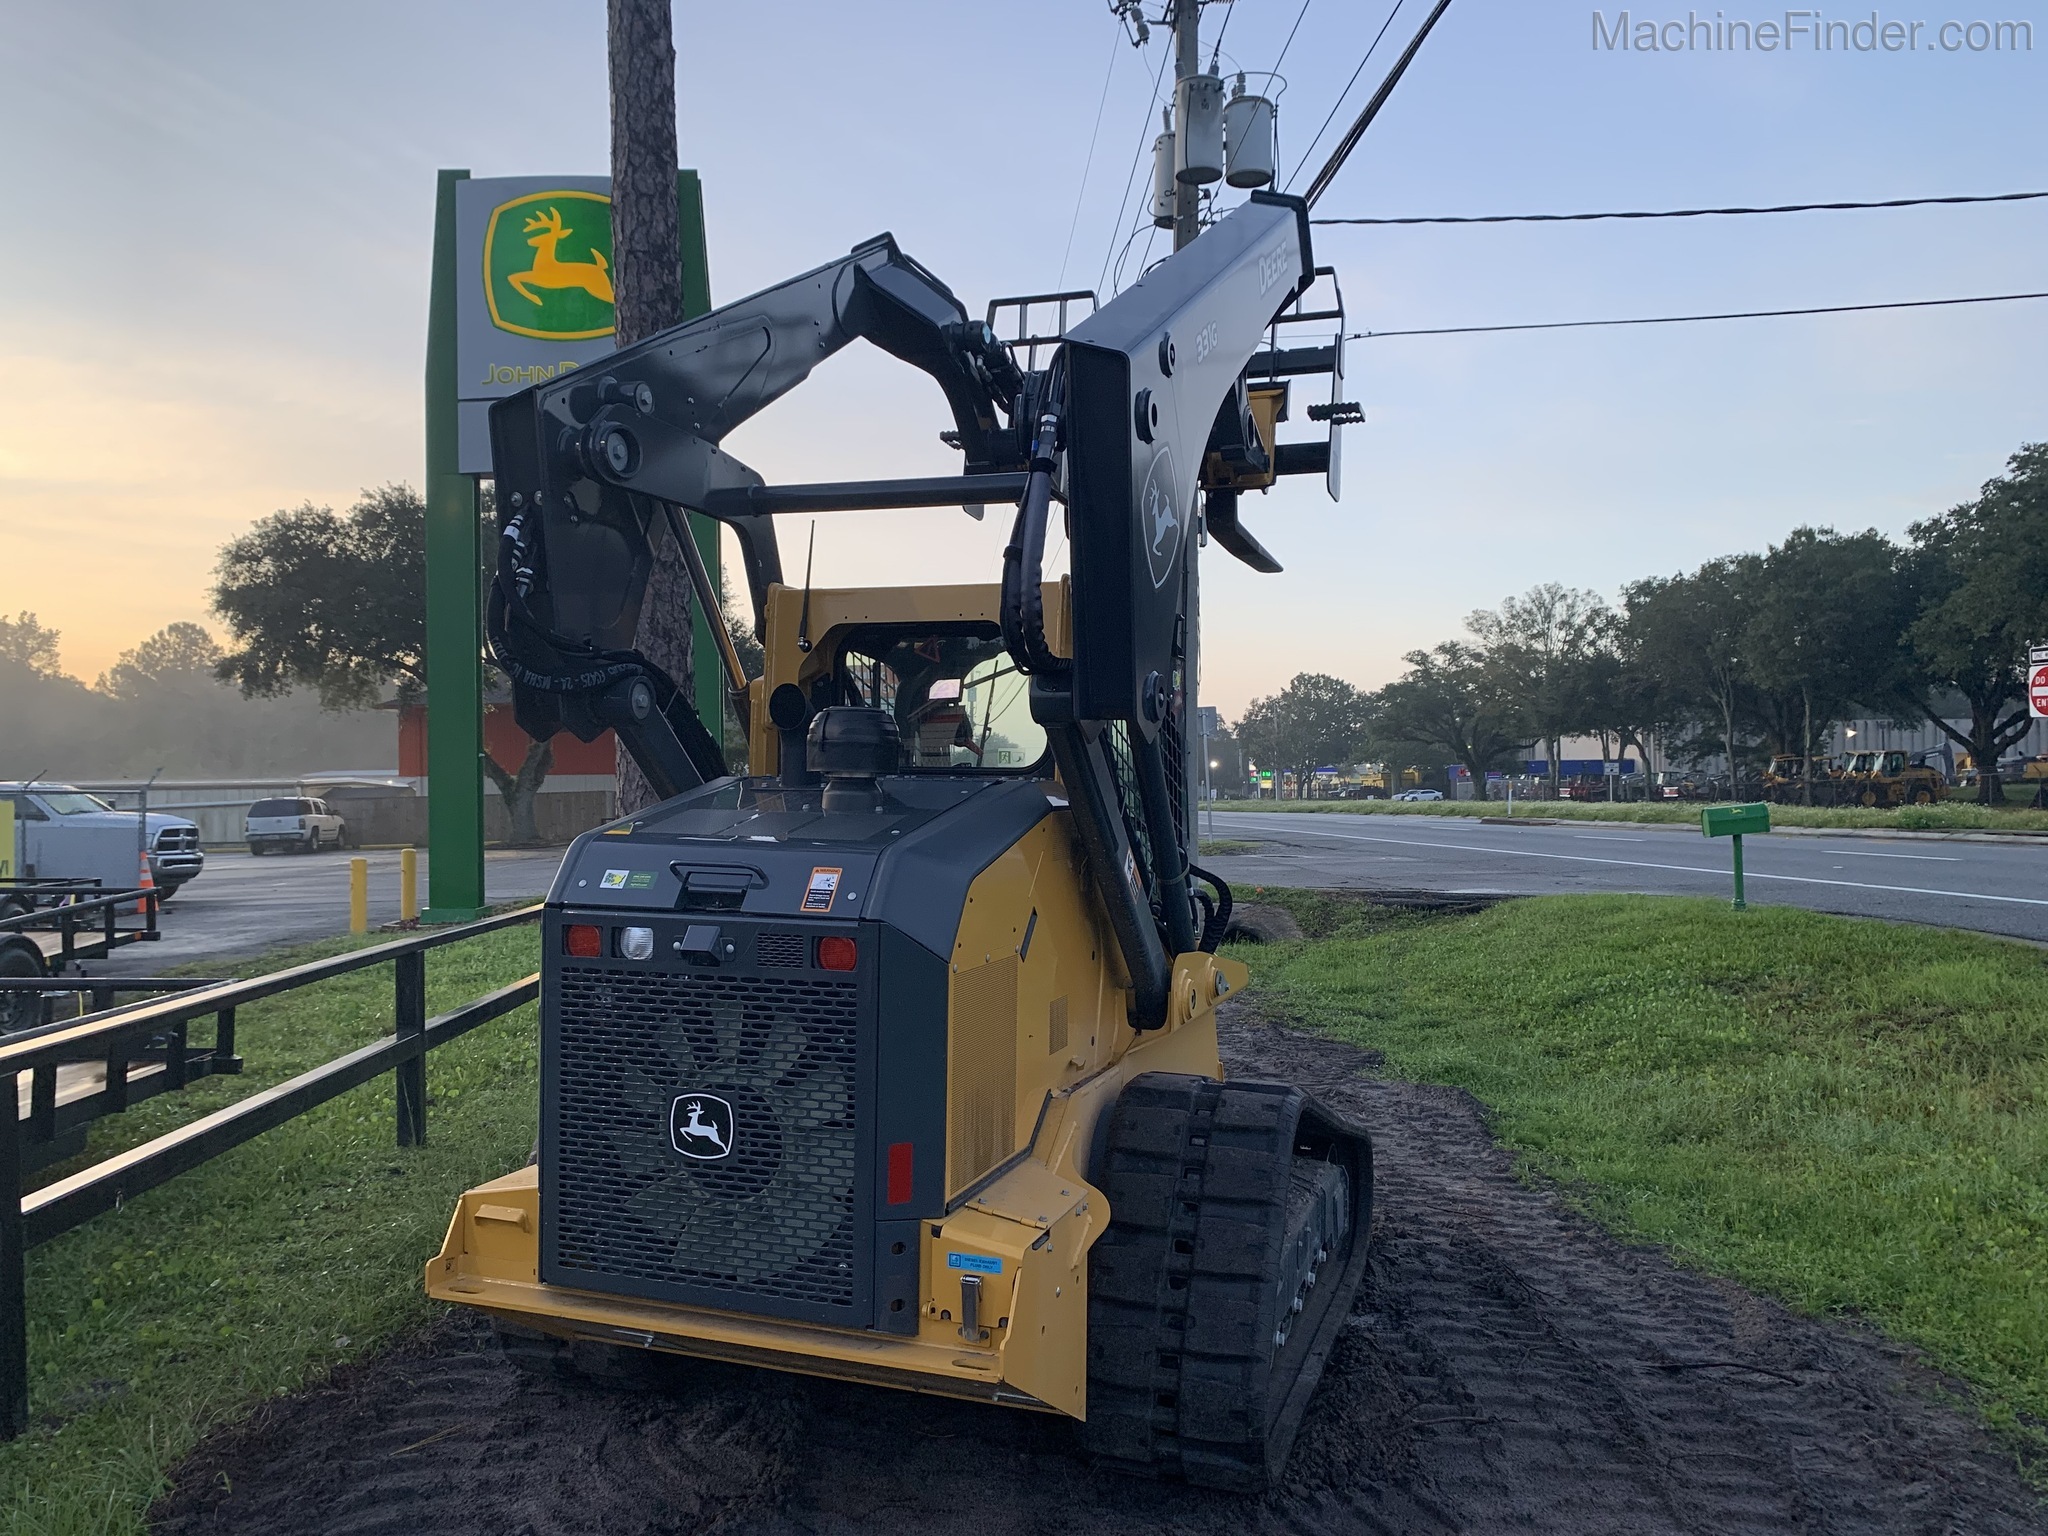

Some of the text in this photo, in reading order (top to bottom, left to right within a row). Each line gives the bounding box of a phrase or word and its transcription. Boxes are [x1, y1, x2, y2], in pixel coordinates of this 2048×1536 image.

[1258, 240, 1288, 297] DEERE
[1195, 321, 1218, 365] 331G
[481, 363, 555, 385] JOHN
[2035, 676, 2046, 684] DO
